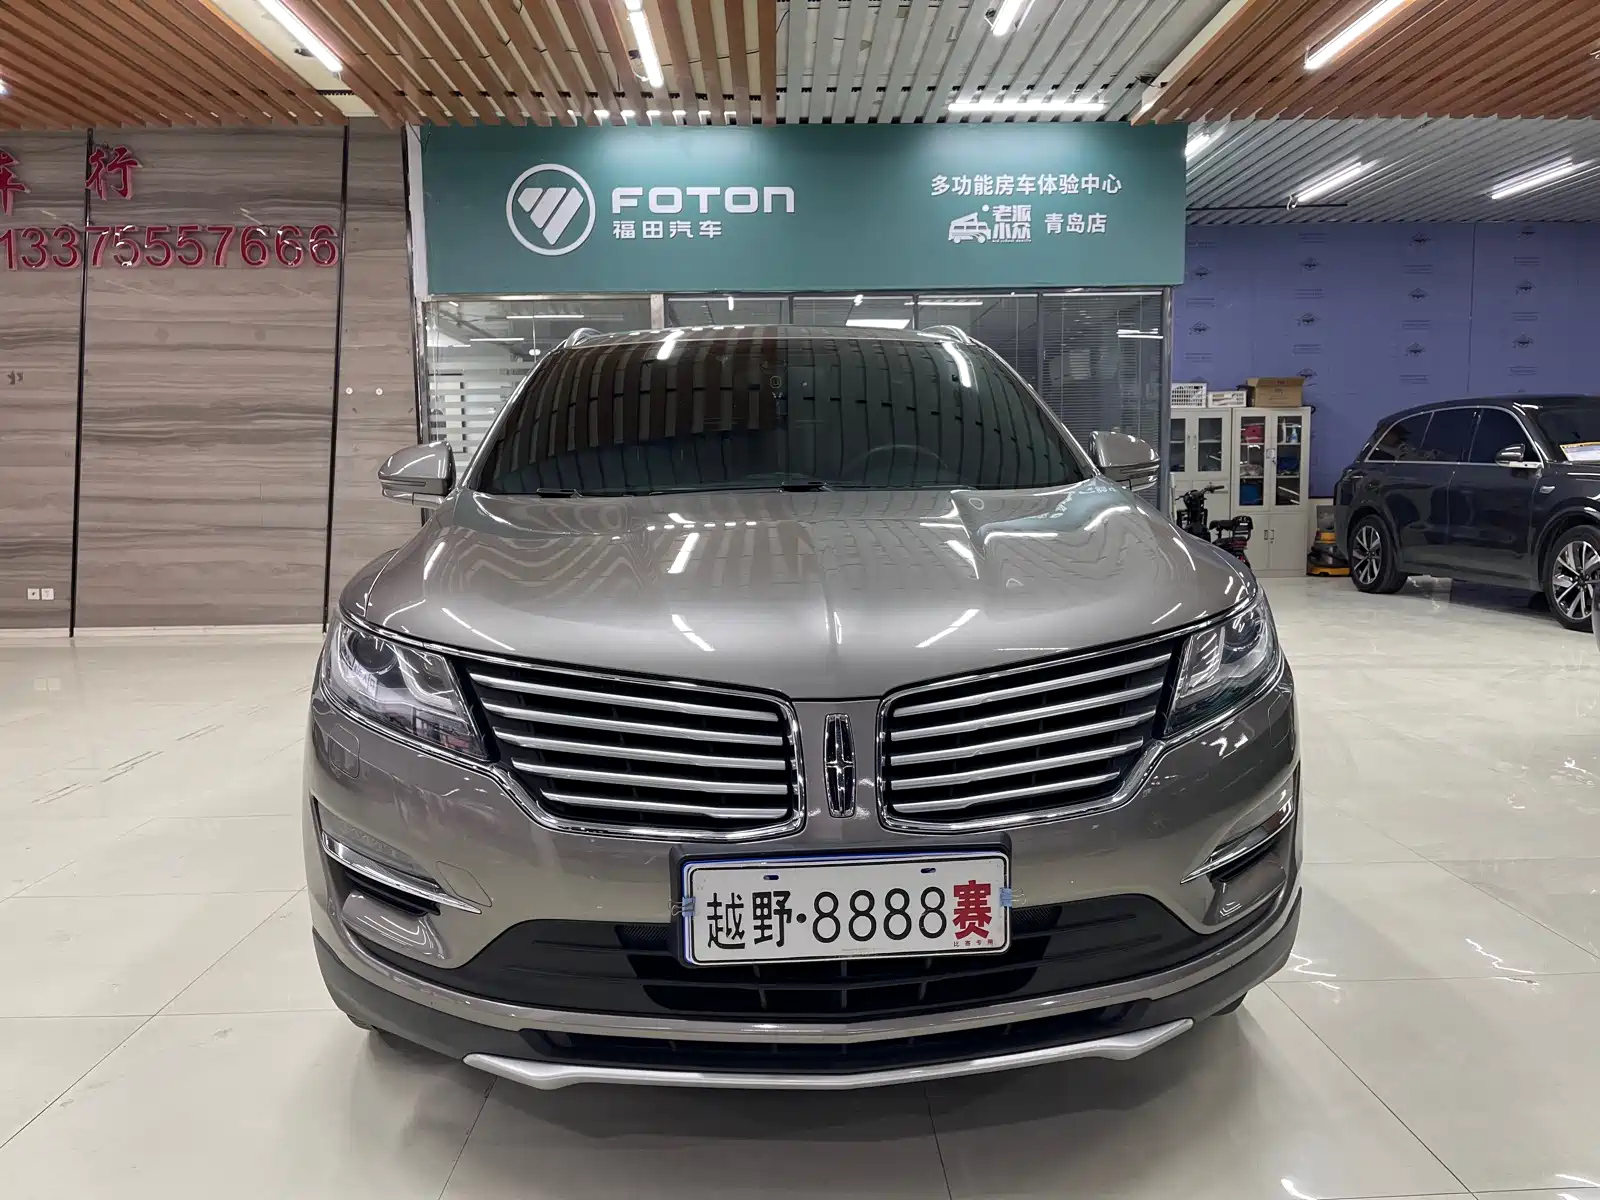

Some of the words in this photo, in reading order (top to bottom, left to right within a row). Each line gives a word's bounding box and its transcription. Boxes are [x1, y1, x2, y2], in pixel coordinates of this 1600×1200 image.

[931, 173, 1122, 196] 多功能房车体验中心
[611, 186, 796, 214] FOTON
[613, 220, 722, 239] 福田汽车
[1044, 212, 1108, 234] 青岛店
[0, 224, 339, 271] 13375557666
